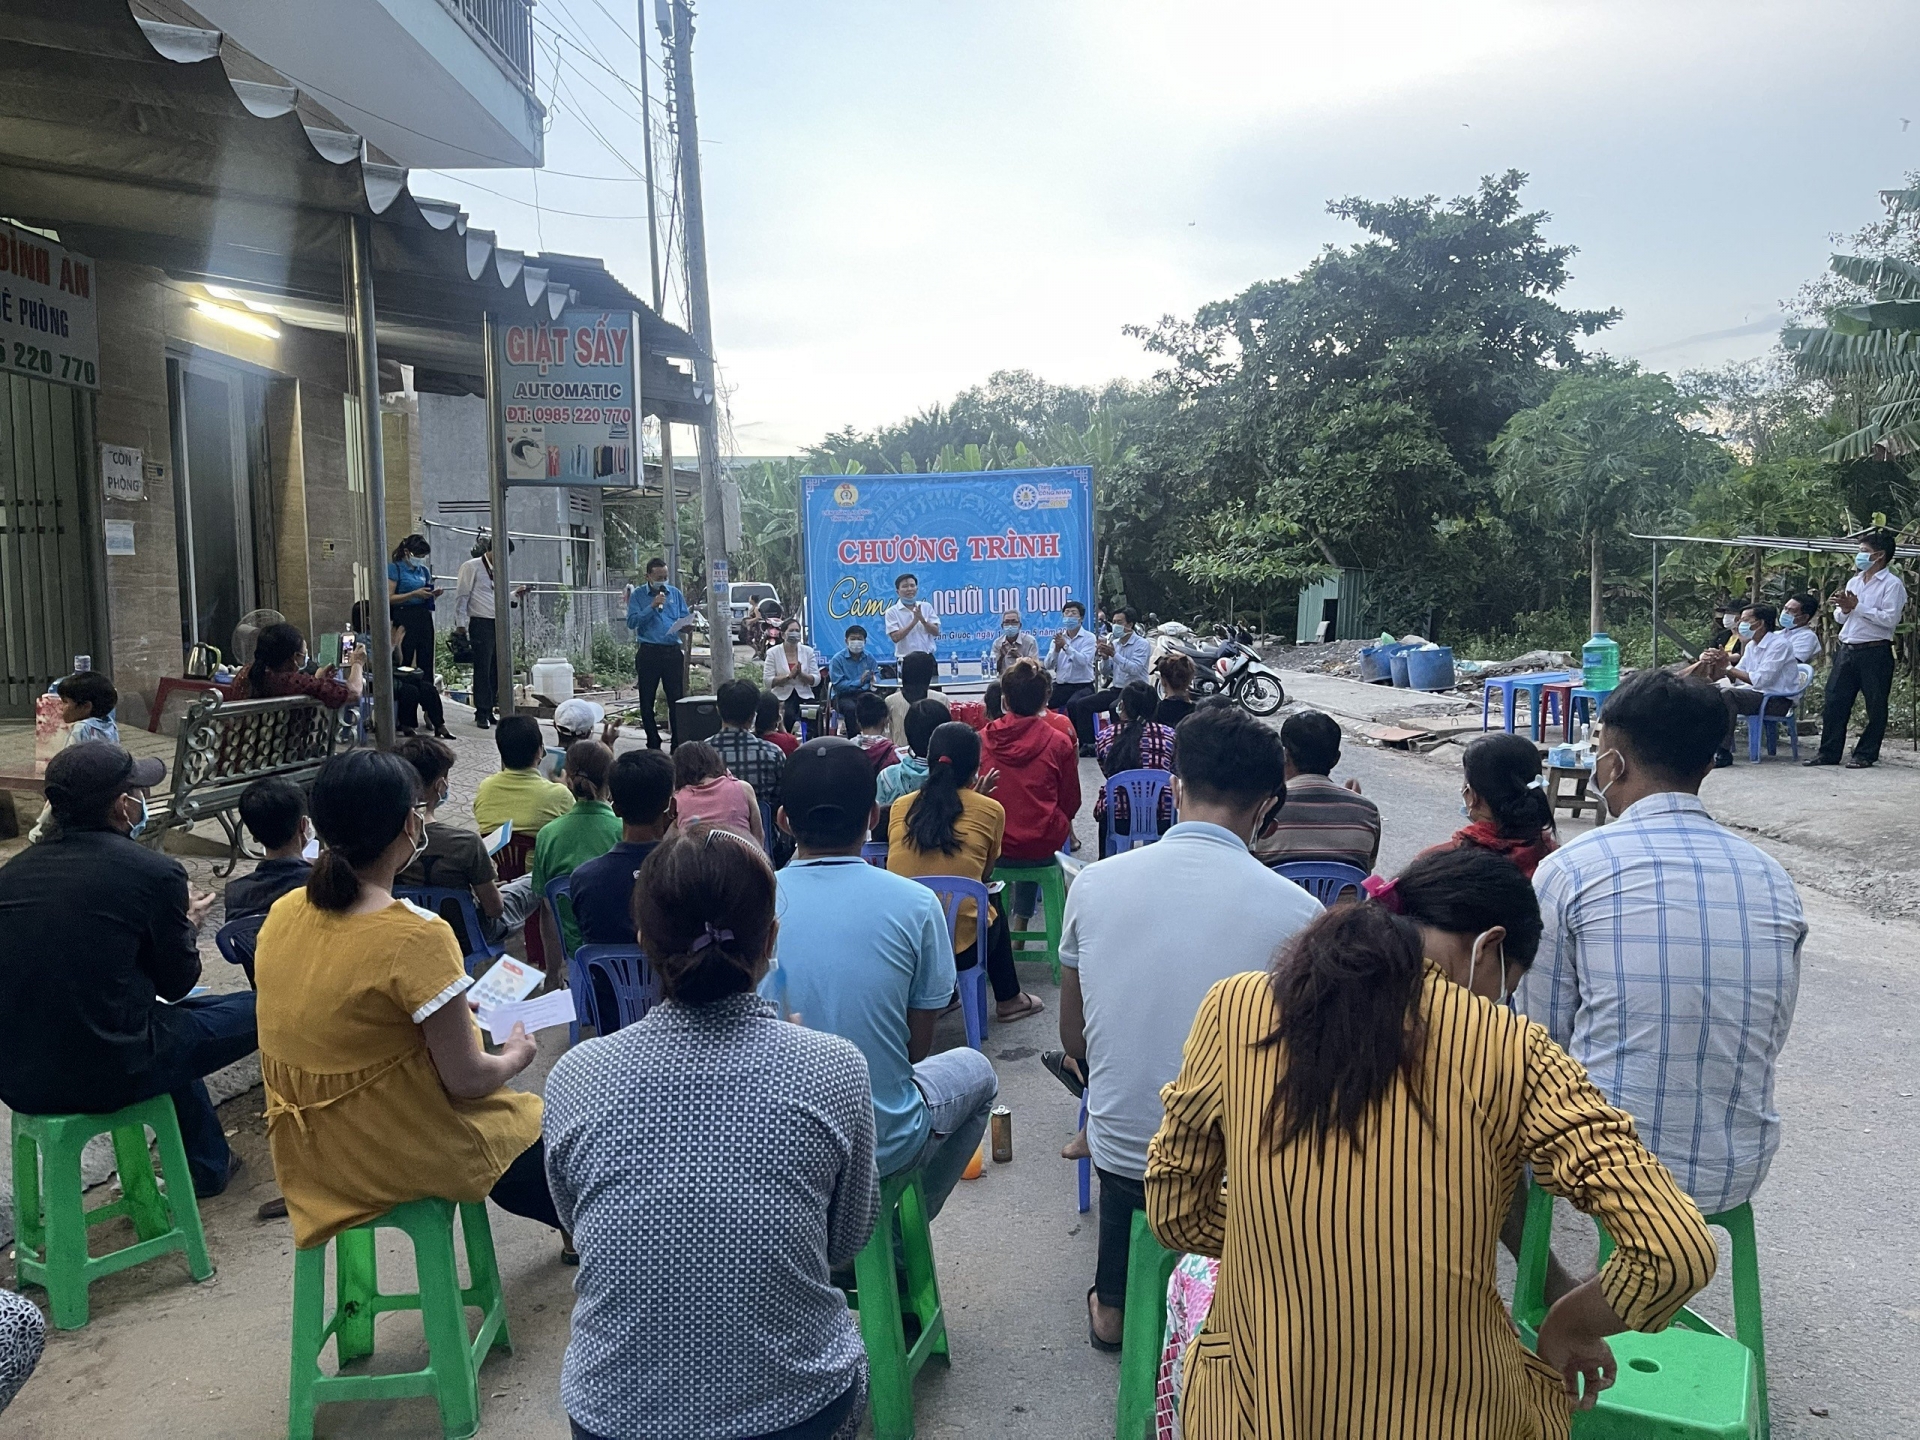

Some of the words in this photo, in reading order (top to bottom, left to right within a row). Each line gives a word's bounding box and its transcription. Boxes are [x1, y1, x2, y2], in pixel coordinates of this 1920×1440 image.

[60, 257, 90, 299] AN
[19, 298, 69, 338] PHÒNG
[507, 320, 568, 375] GIẶT
[576, 313, 629, 366] SẤY
[14, 342, 52, 374] 220
[59, 354, 96, 385] 770
[514, 382, 622, 399] AUTOMATIC
[506, 406, 531, 422] ĐT:
[534, 407, 571, 422] 0985
[574, 408, 601, 423] 220
[604, 408, 631, 423] 770
[107, 474, 139, 492] PHÒNG
[838, 533, 959, 565] CHƯƠNG
[966, 527, 1061, 561] TRÌNH
[932, 584, 984, 615] NGƯỜI
[988, 586, 1020, 614] LAO
